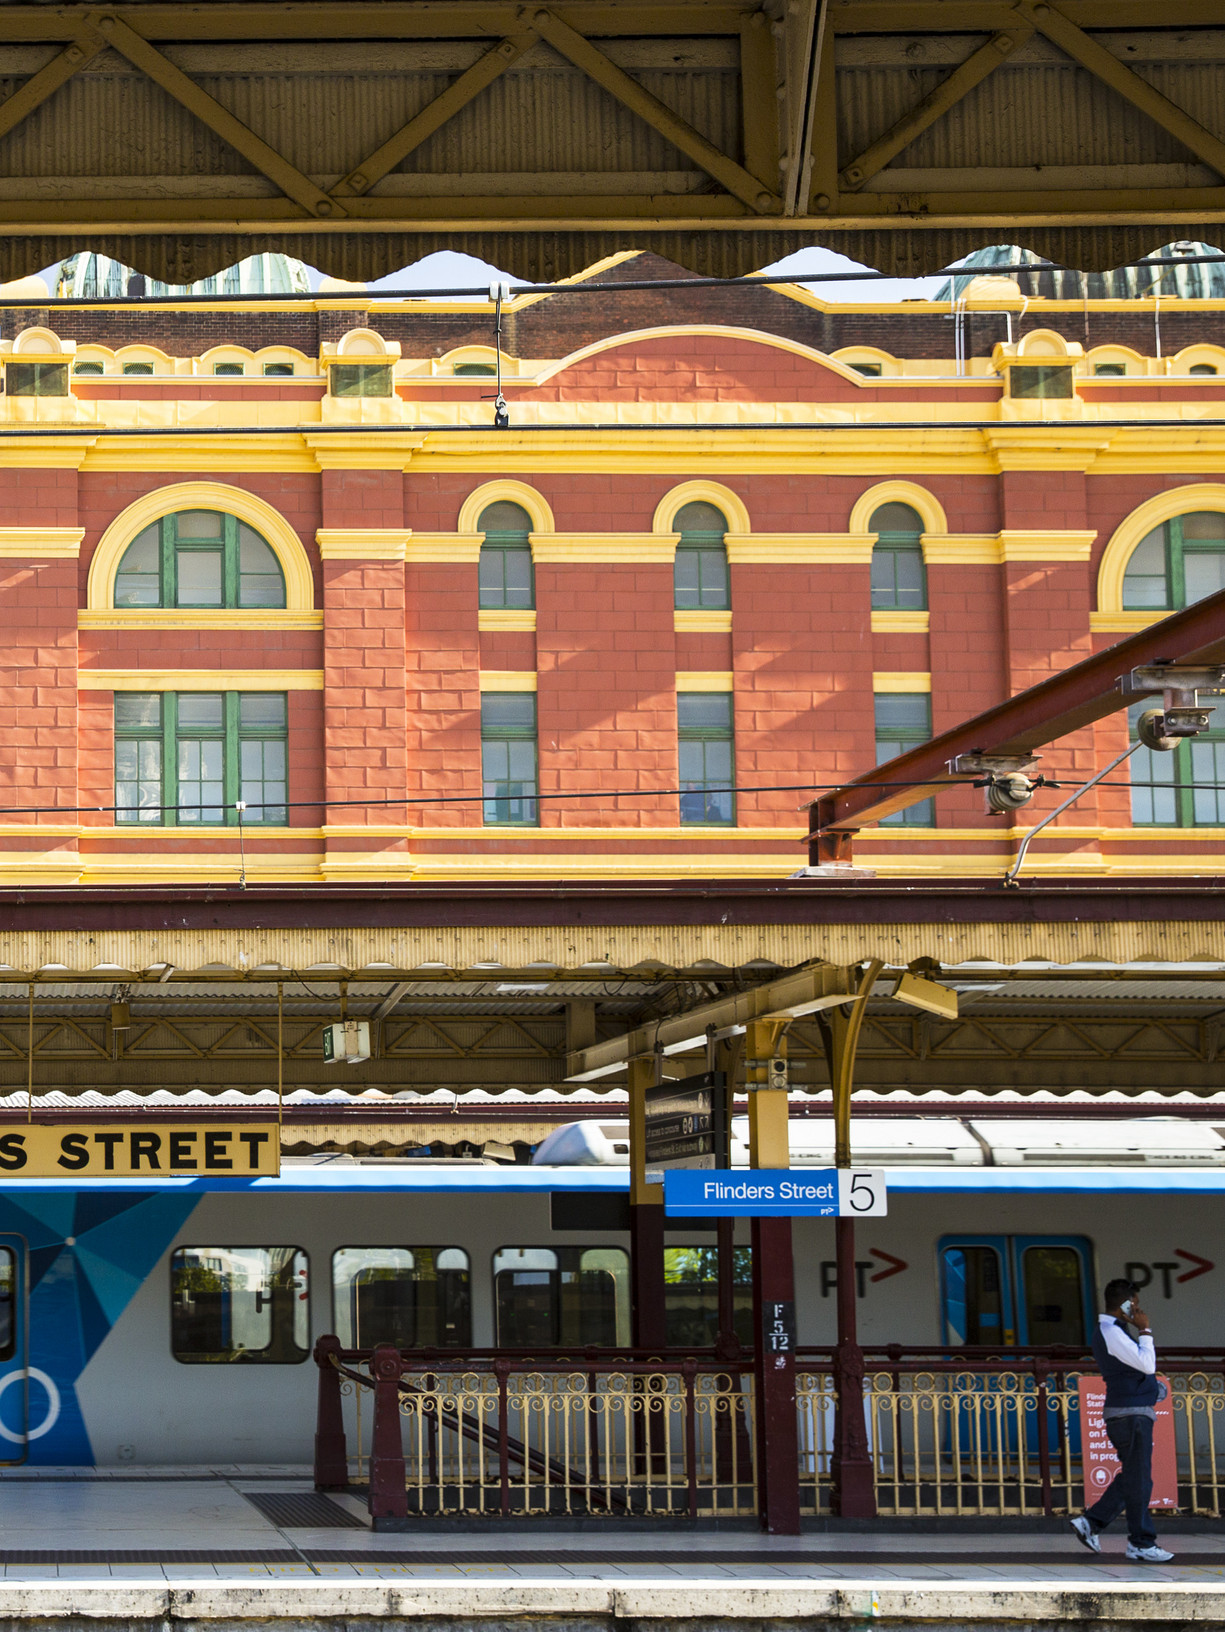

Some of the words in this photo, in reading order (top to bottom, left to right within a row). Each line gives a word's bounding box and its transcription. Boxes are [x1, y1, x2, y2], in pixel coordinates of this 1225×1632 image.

[57, 1131, 269, 1170] STREET
[704, 1181, 775, 1199] Flinders
[779, 1181, 834, 1199] Street
[849, 1173, 876, 1212] 5
[774, 1304, 784, 1318] F
[771, 1336, 789, 1350] 12
[1089, 1441, 1106, 1449] and
[1090, 1451, 1099, 1460] in
